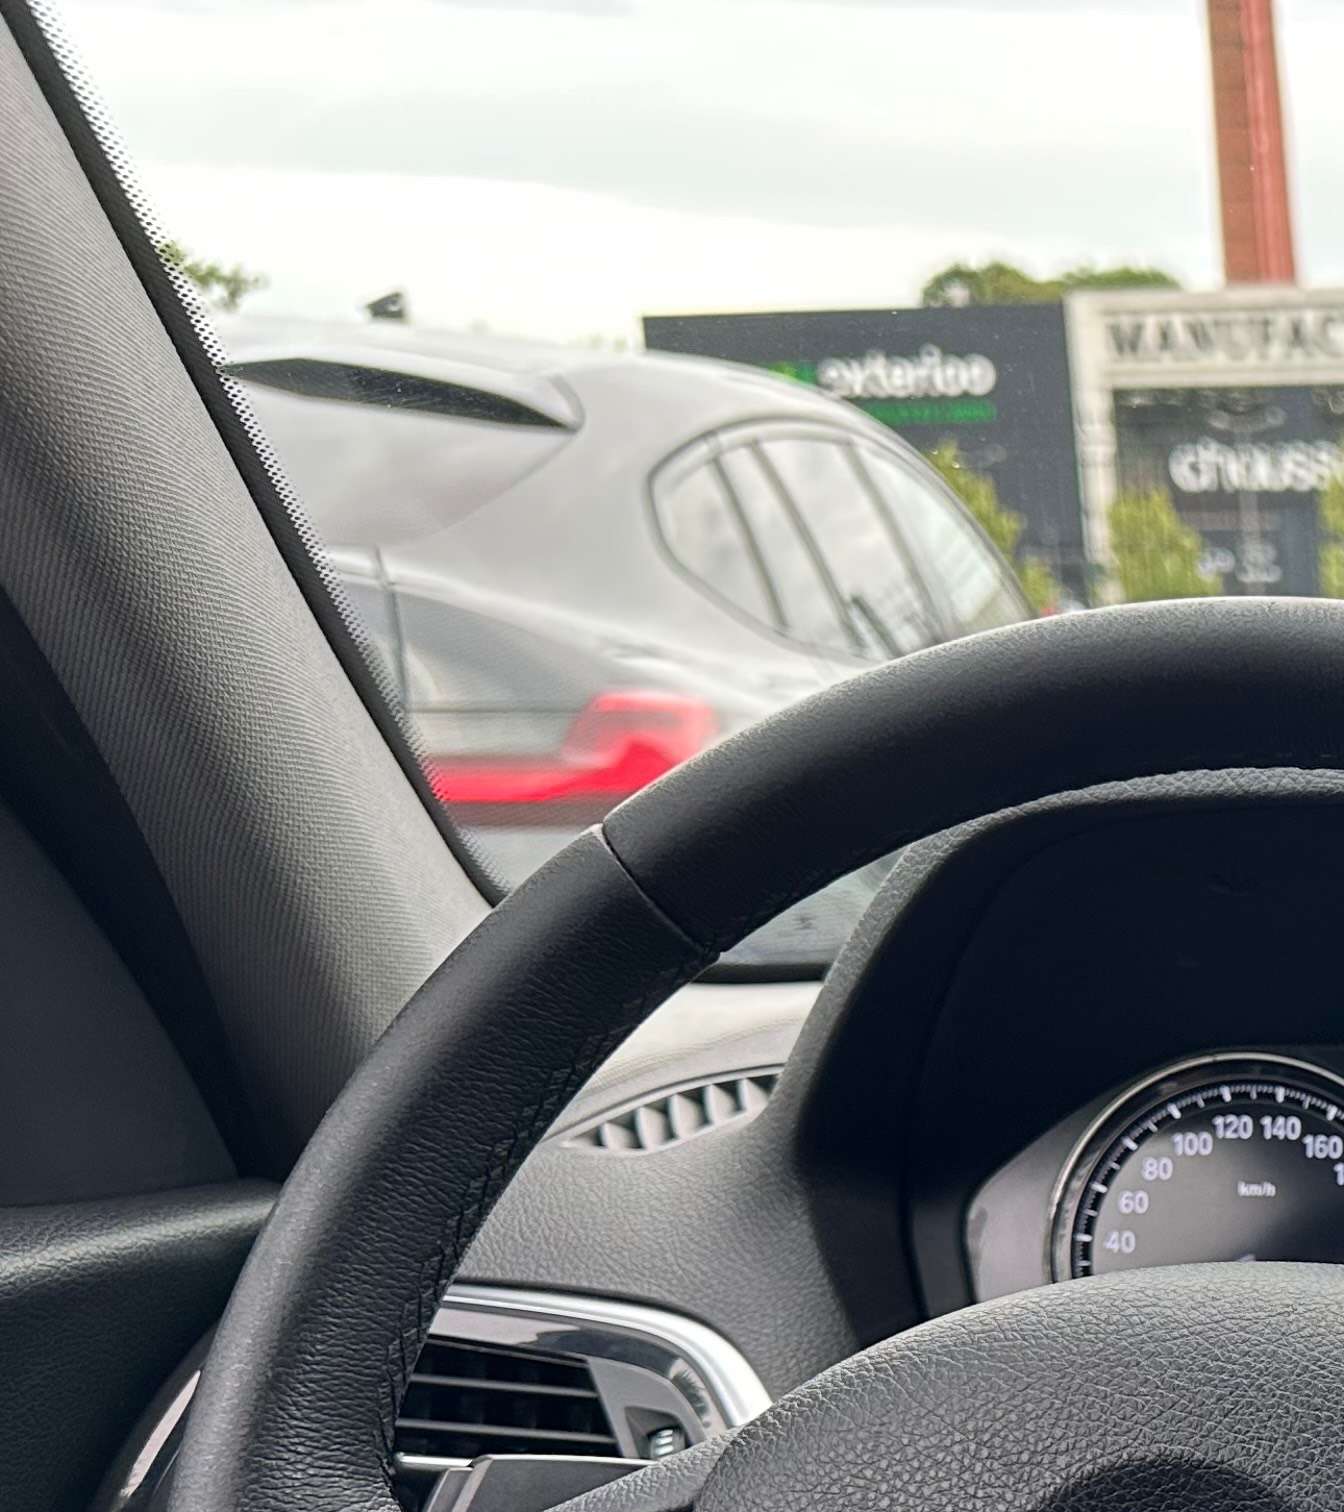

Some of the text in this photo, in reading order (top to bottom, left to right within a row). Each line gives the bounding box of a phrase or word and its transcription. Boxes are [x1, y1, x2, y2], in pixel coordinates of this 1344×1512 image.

[1213, 1115, 1254, 1140] 120
[1260, 1115, 1302, 1140] 140
[1172, 1132, 1213, 1156] 100
[1302, 1135, 1344, 1160] 160
[1142, 1158, 1173, 1181] 80
[1238, 1181, 1277, 1198] km/h
[1118, 1191, 1149, 1214] 60
[1106, 1231, 1136, 1254] 40
